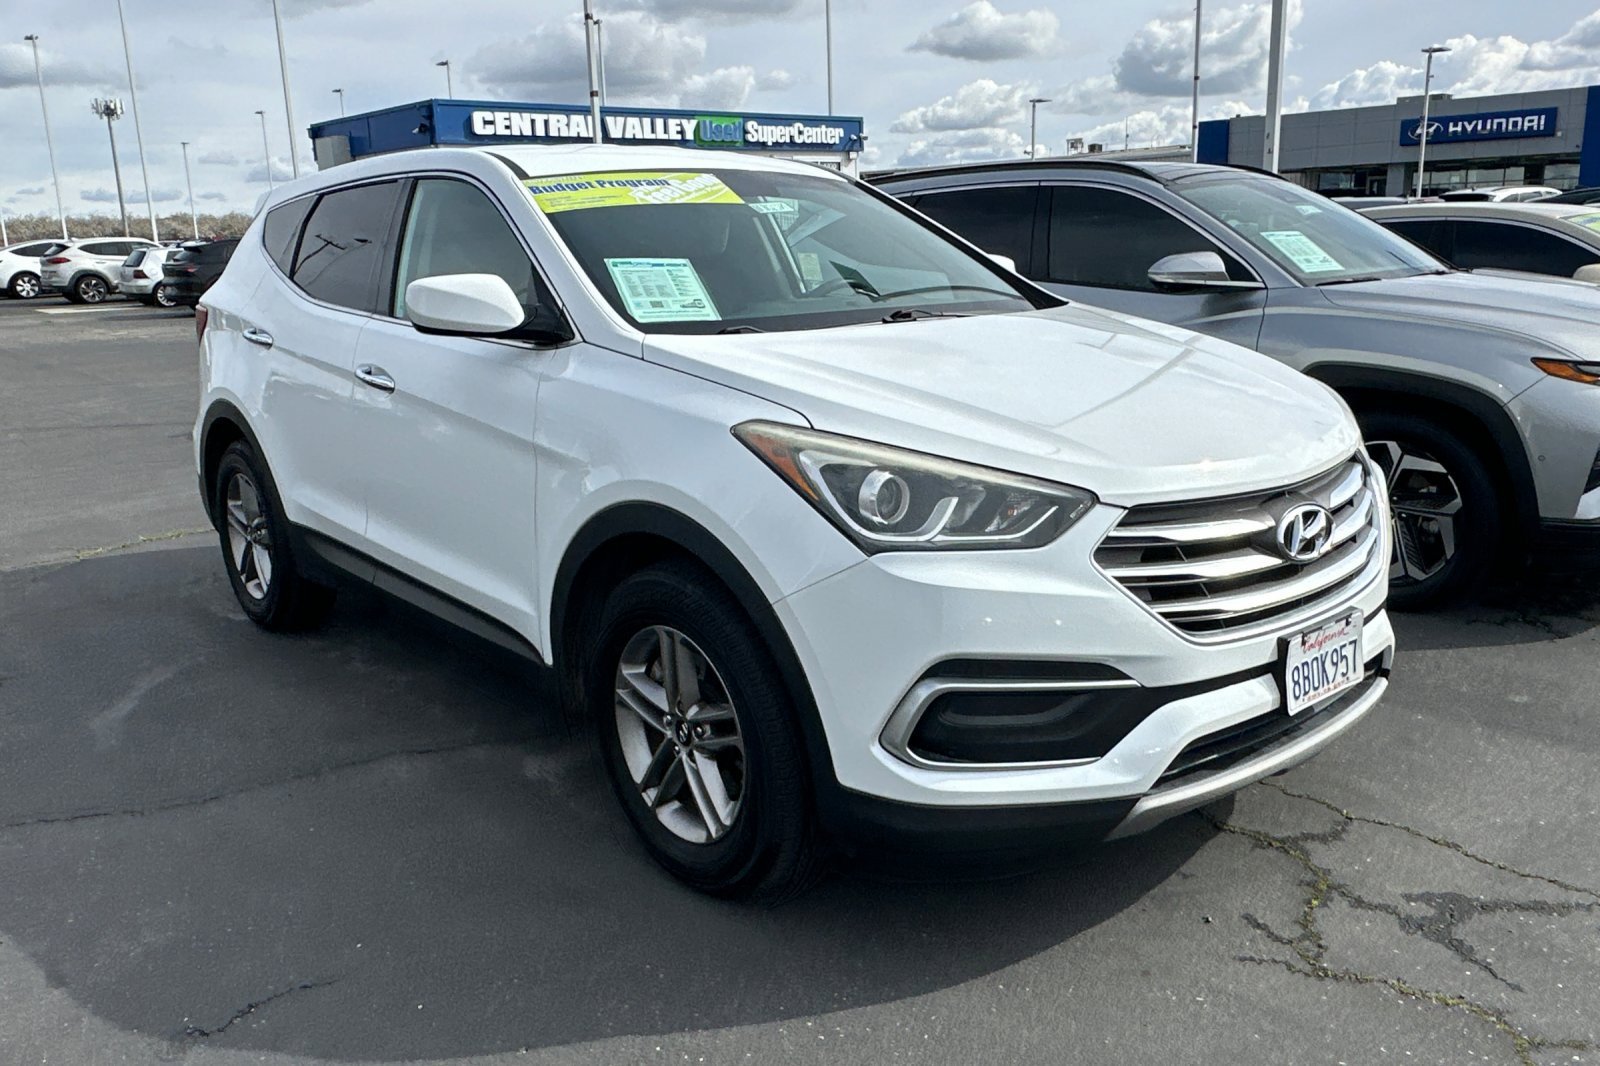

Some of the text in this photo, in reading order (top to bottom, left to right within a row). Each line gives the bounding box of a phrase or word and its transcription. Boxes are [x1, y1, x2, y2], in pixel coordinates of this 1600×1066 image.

[605, 116, 698, 140] VALLEY
[701, 118, 743, 142] Used
[746, 121, 844, 146] SuperCenter
[1448, 114, 1546, 136] HYUNDAI
[528, 181, 596, 195] Budget
[595, 179, 671, 188] Program
